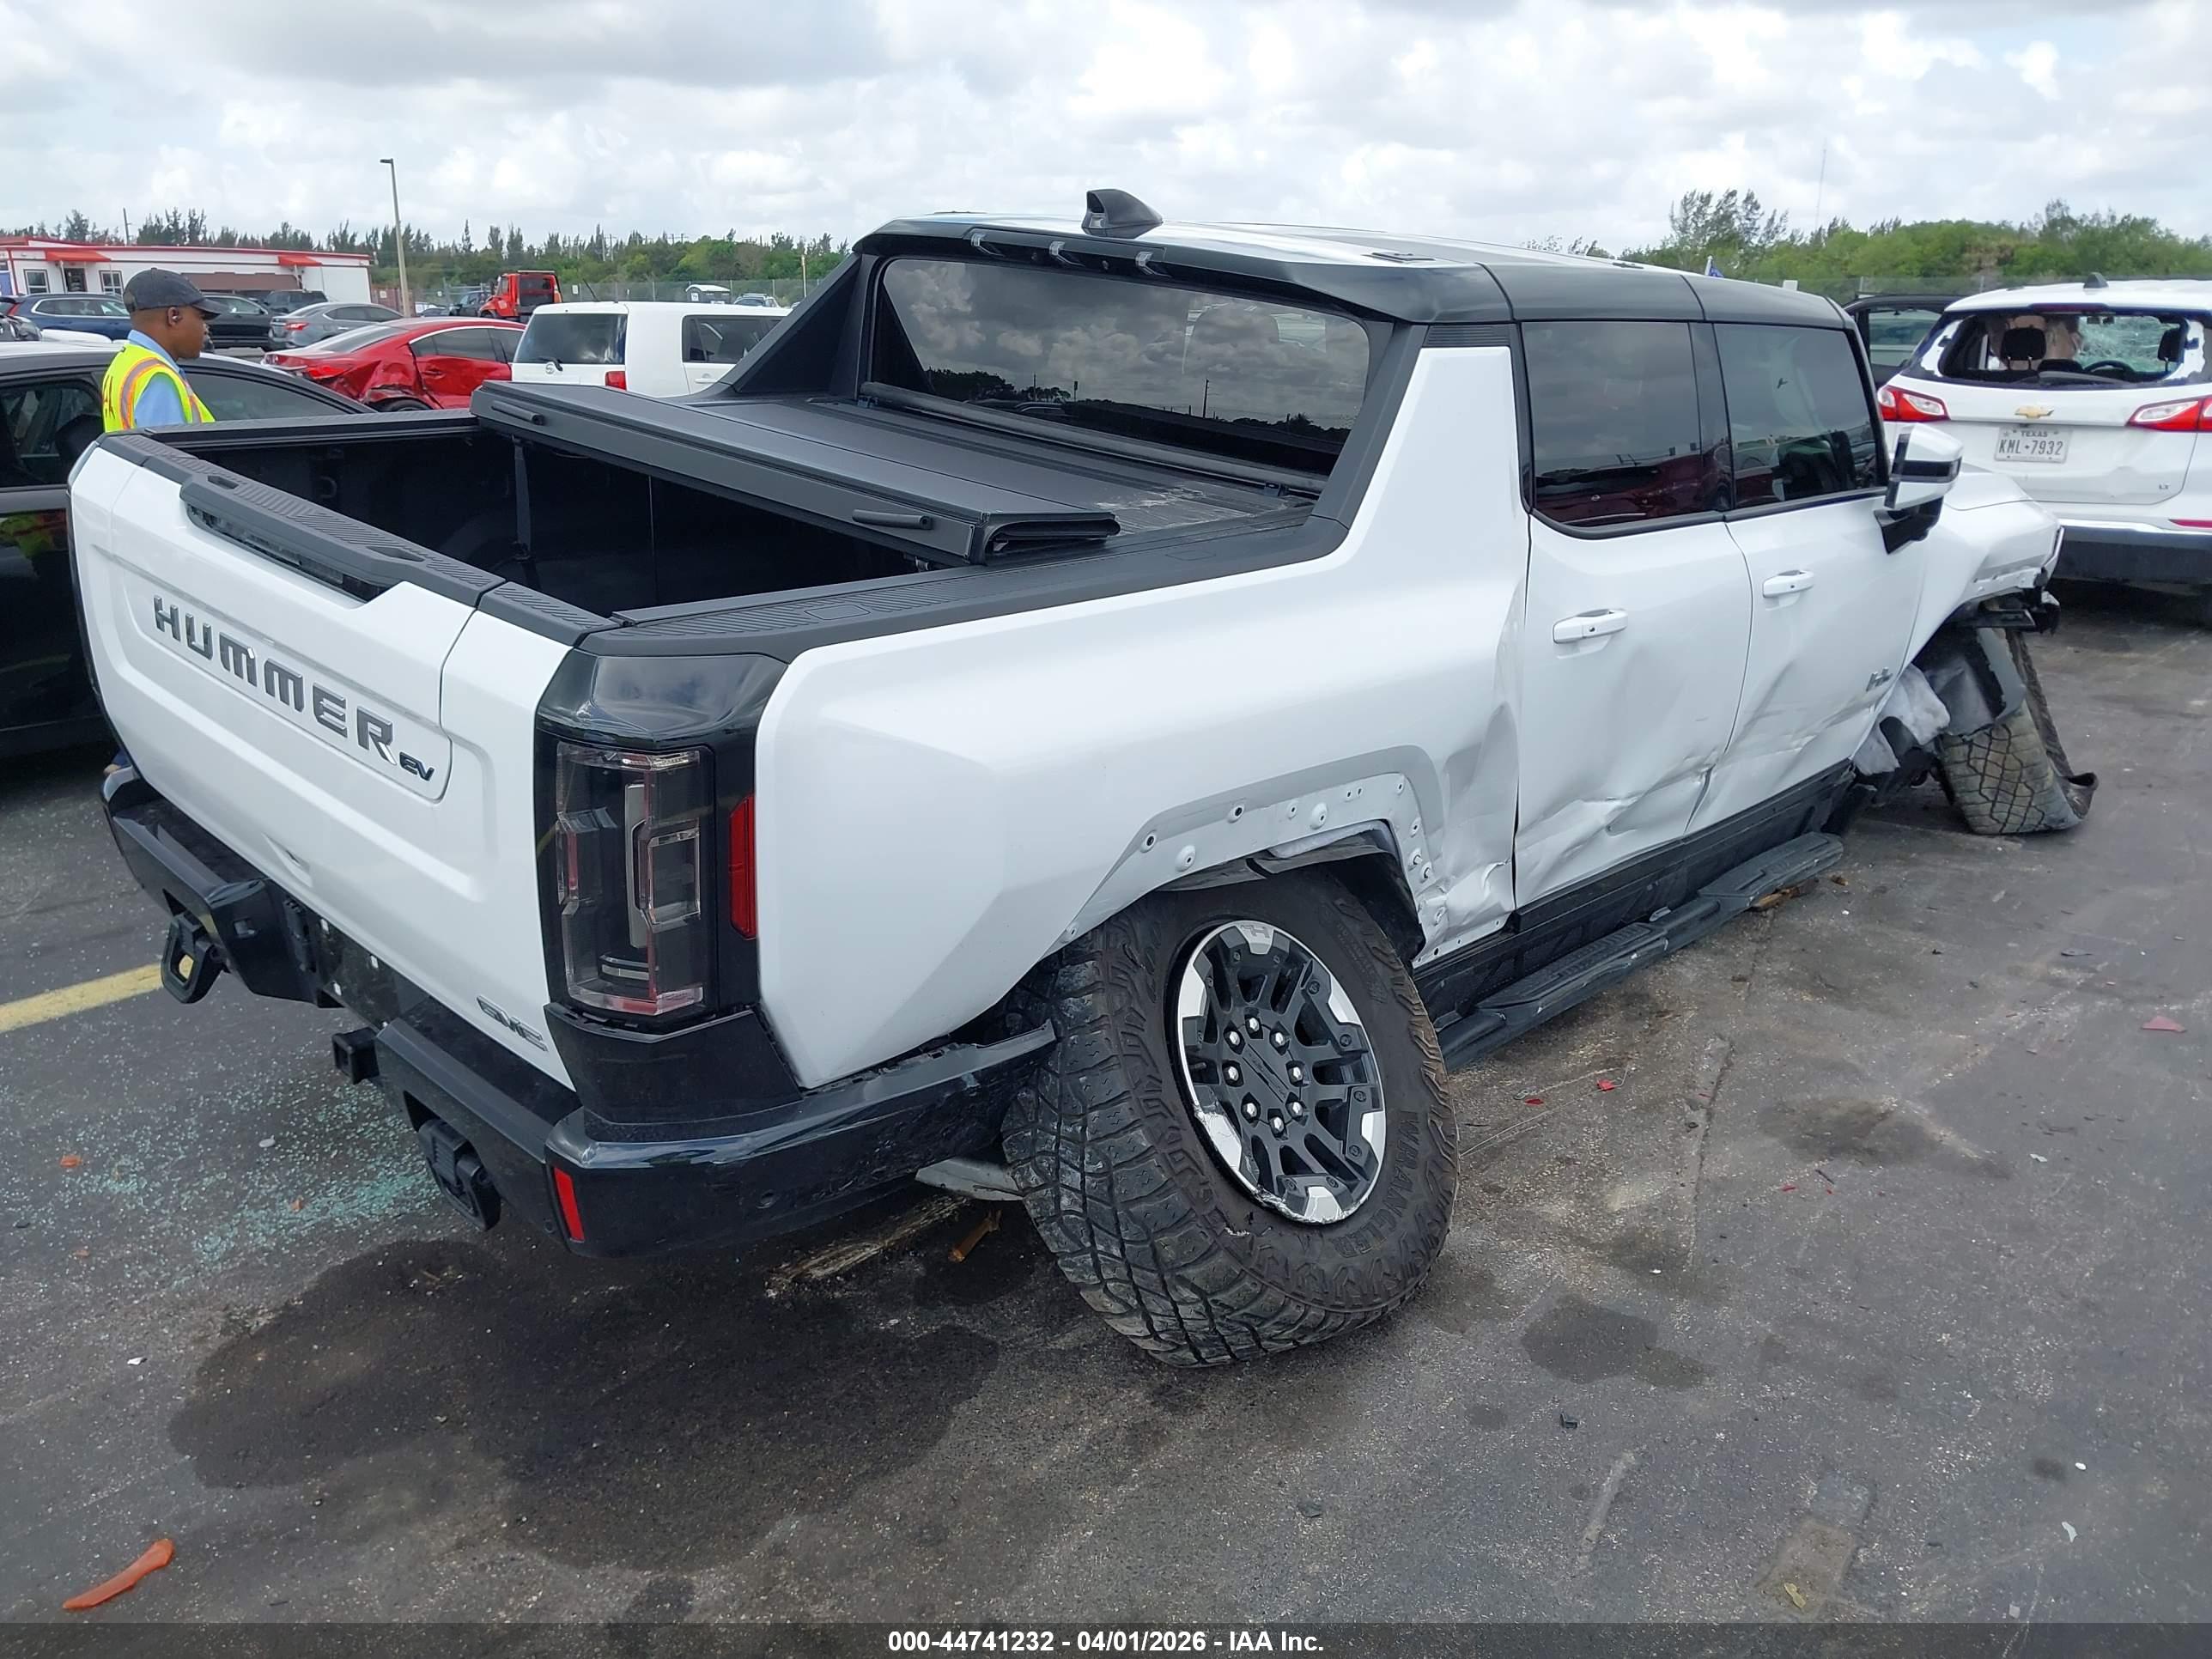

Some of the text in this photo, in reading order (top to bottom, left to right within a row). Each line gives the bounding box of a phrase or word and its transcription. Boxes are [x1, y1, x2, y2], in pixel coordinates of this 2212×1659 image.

[154, 595, 398, 766] HUMMER
[476, 994, 549, 1052] GMC
[1330, 1110, 1419, 1258] WRANGLER
